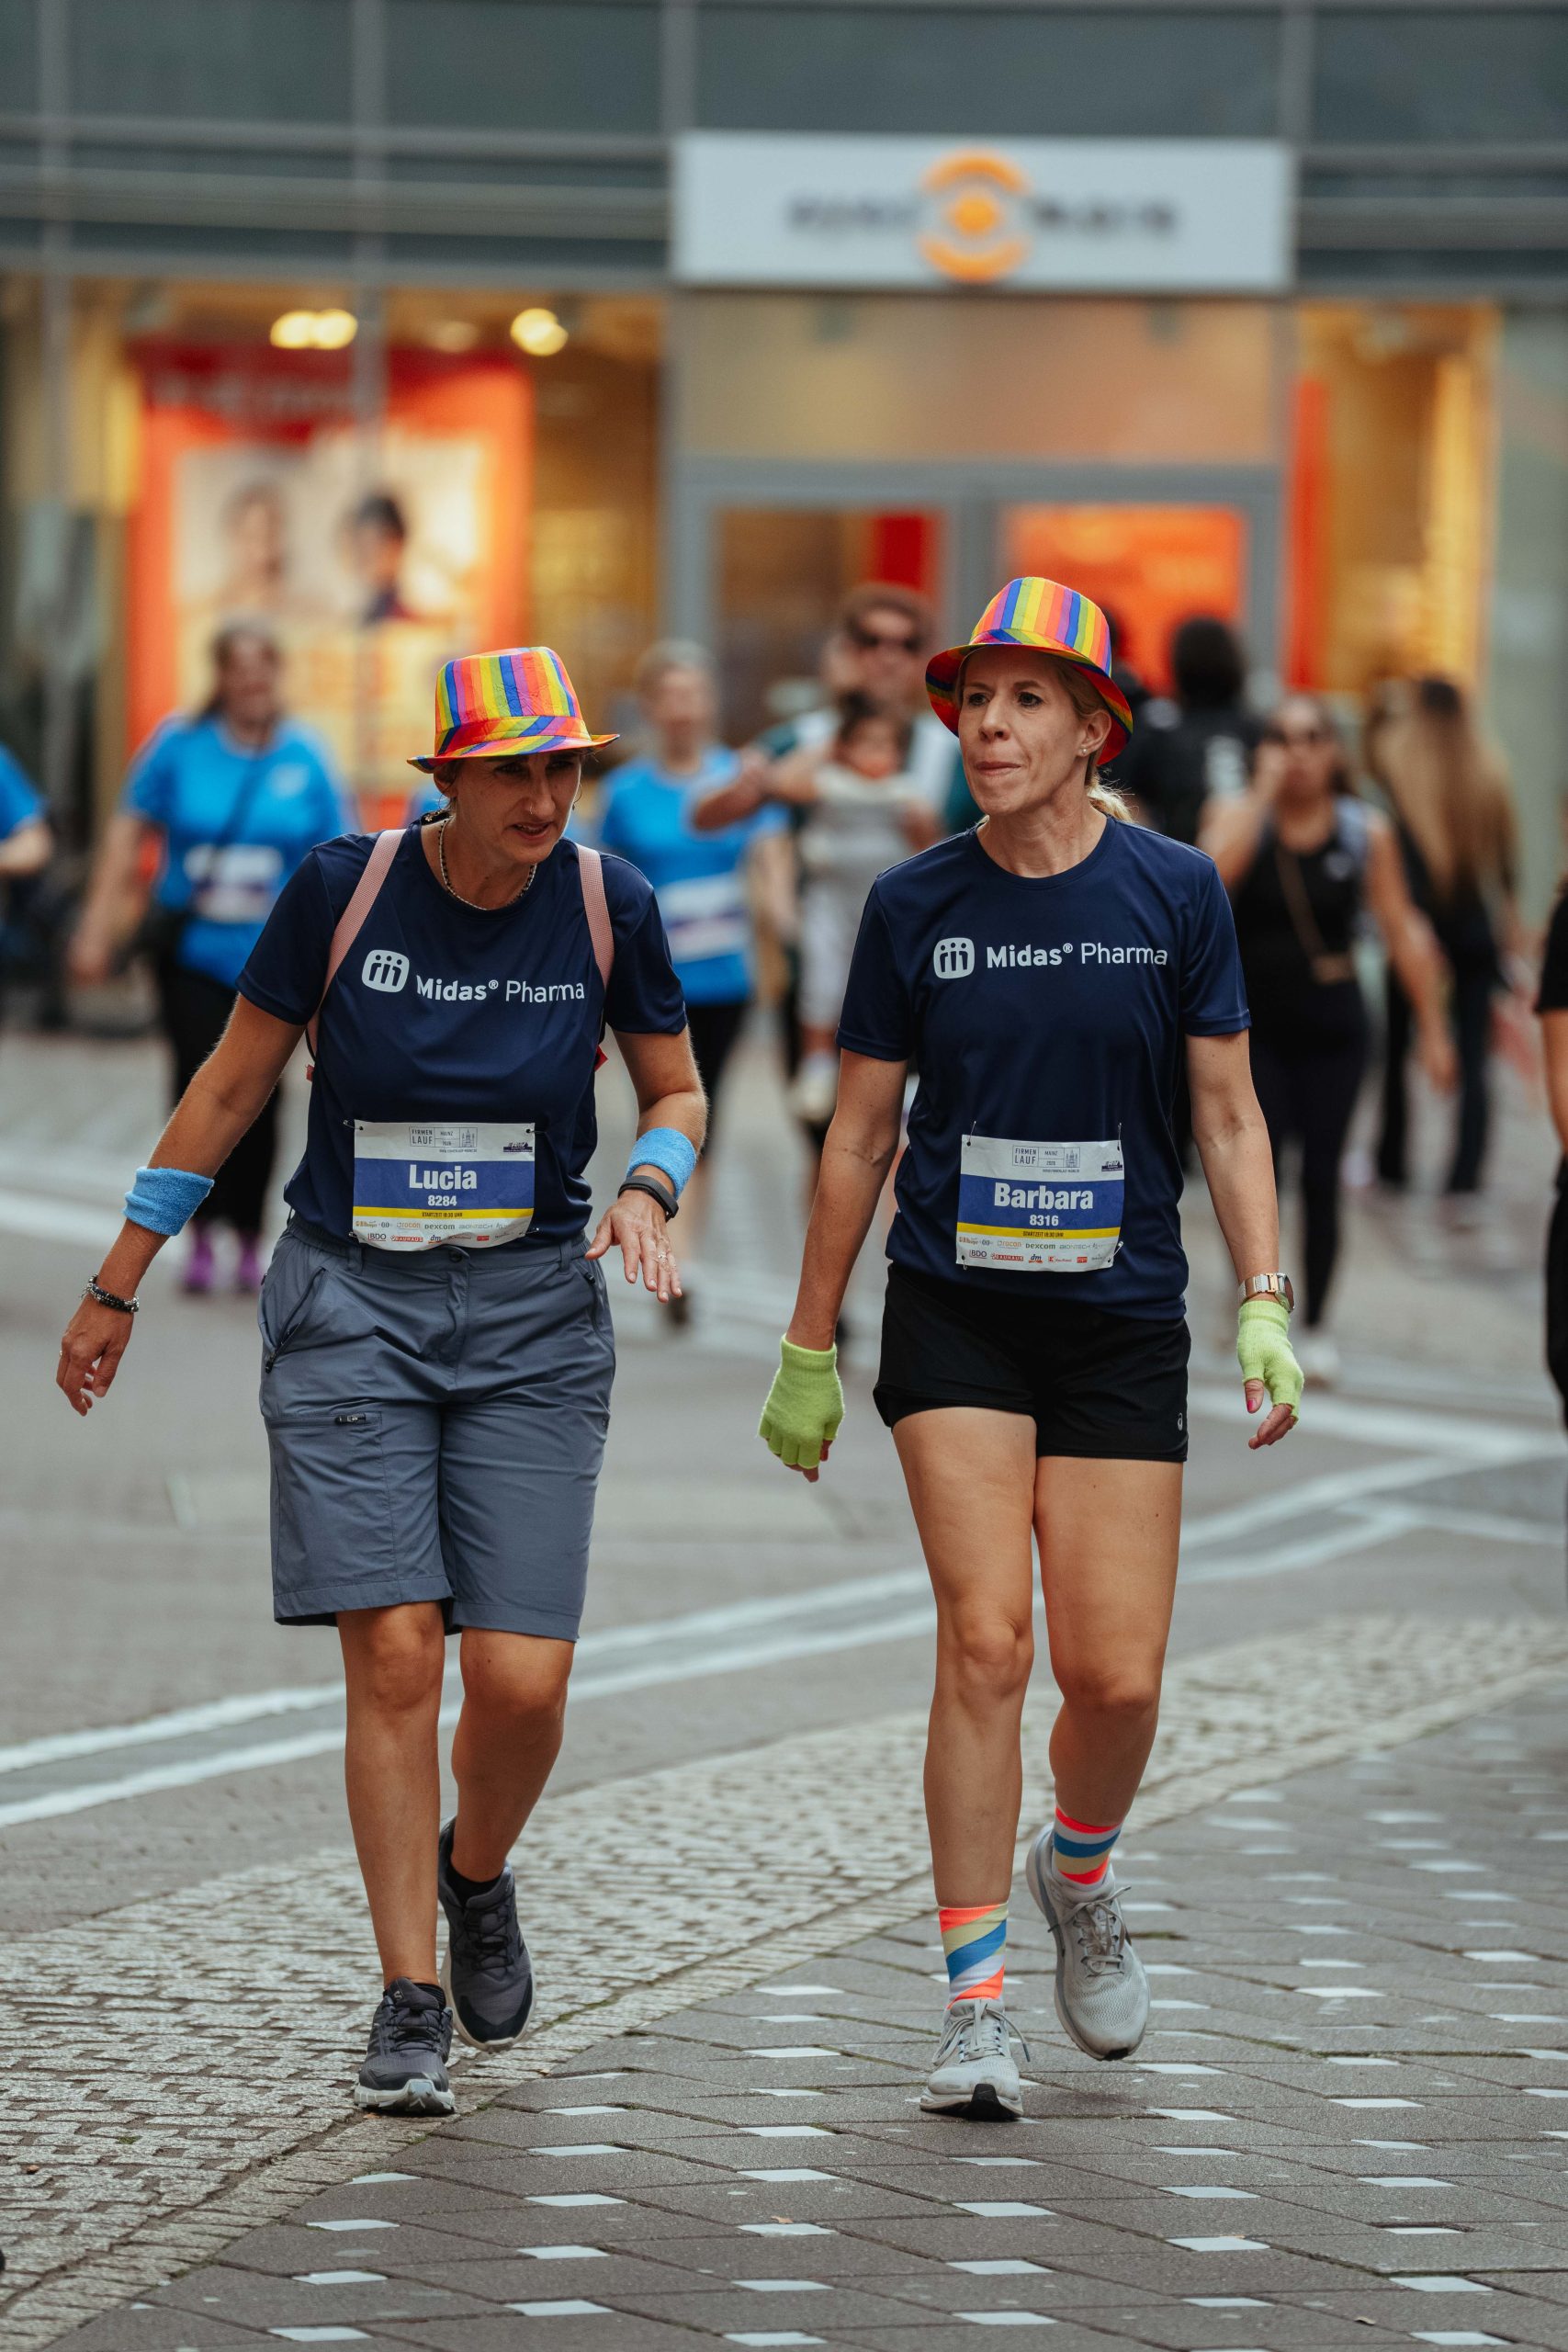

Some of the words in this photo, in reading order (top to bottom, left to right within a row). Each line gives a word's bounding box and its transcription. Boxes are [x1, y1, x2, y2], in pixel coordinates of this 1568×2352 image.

[1081, 942, 1168, 966] Pharma
[505, 979, 585, 1003] Pharma
[412, 1136, 433, 1145] LAUF
[1014, 1155, 1036, 1164] LAUF
[409, 1164, 478, 1190] Lucia
[427, 1194, 457, 1206] 8284
[994, 1182, 1093, 1210] Barbara
[1029, 1215, 1059, 1227] 8316
[971, 1250, 987, 1258] BDO
